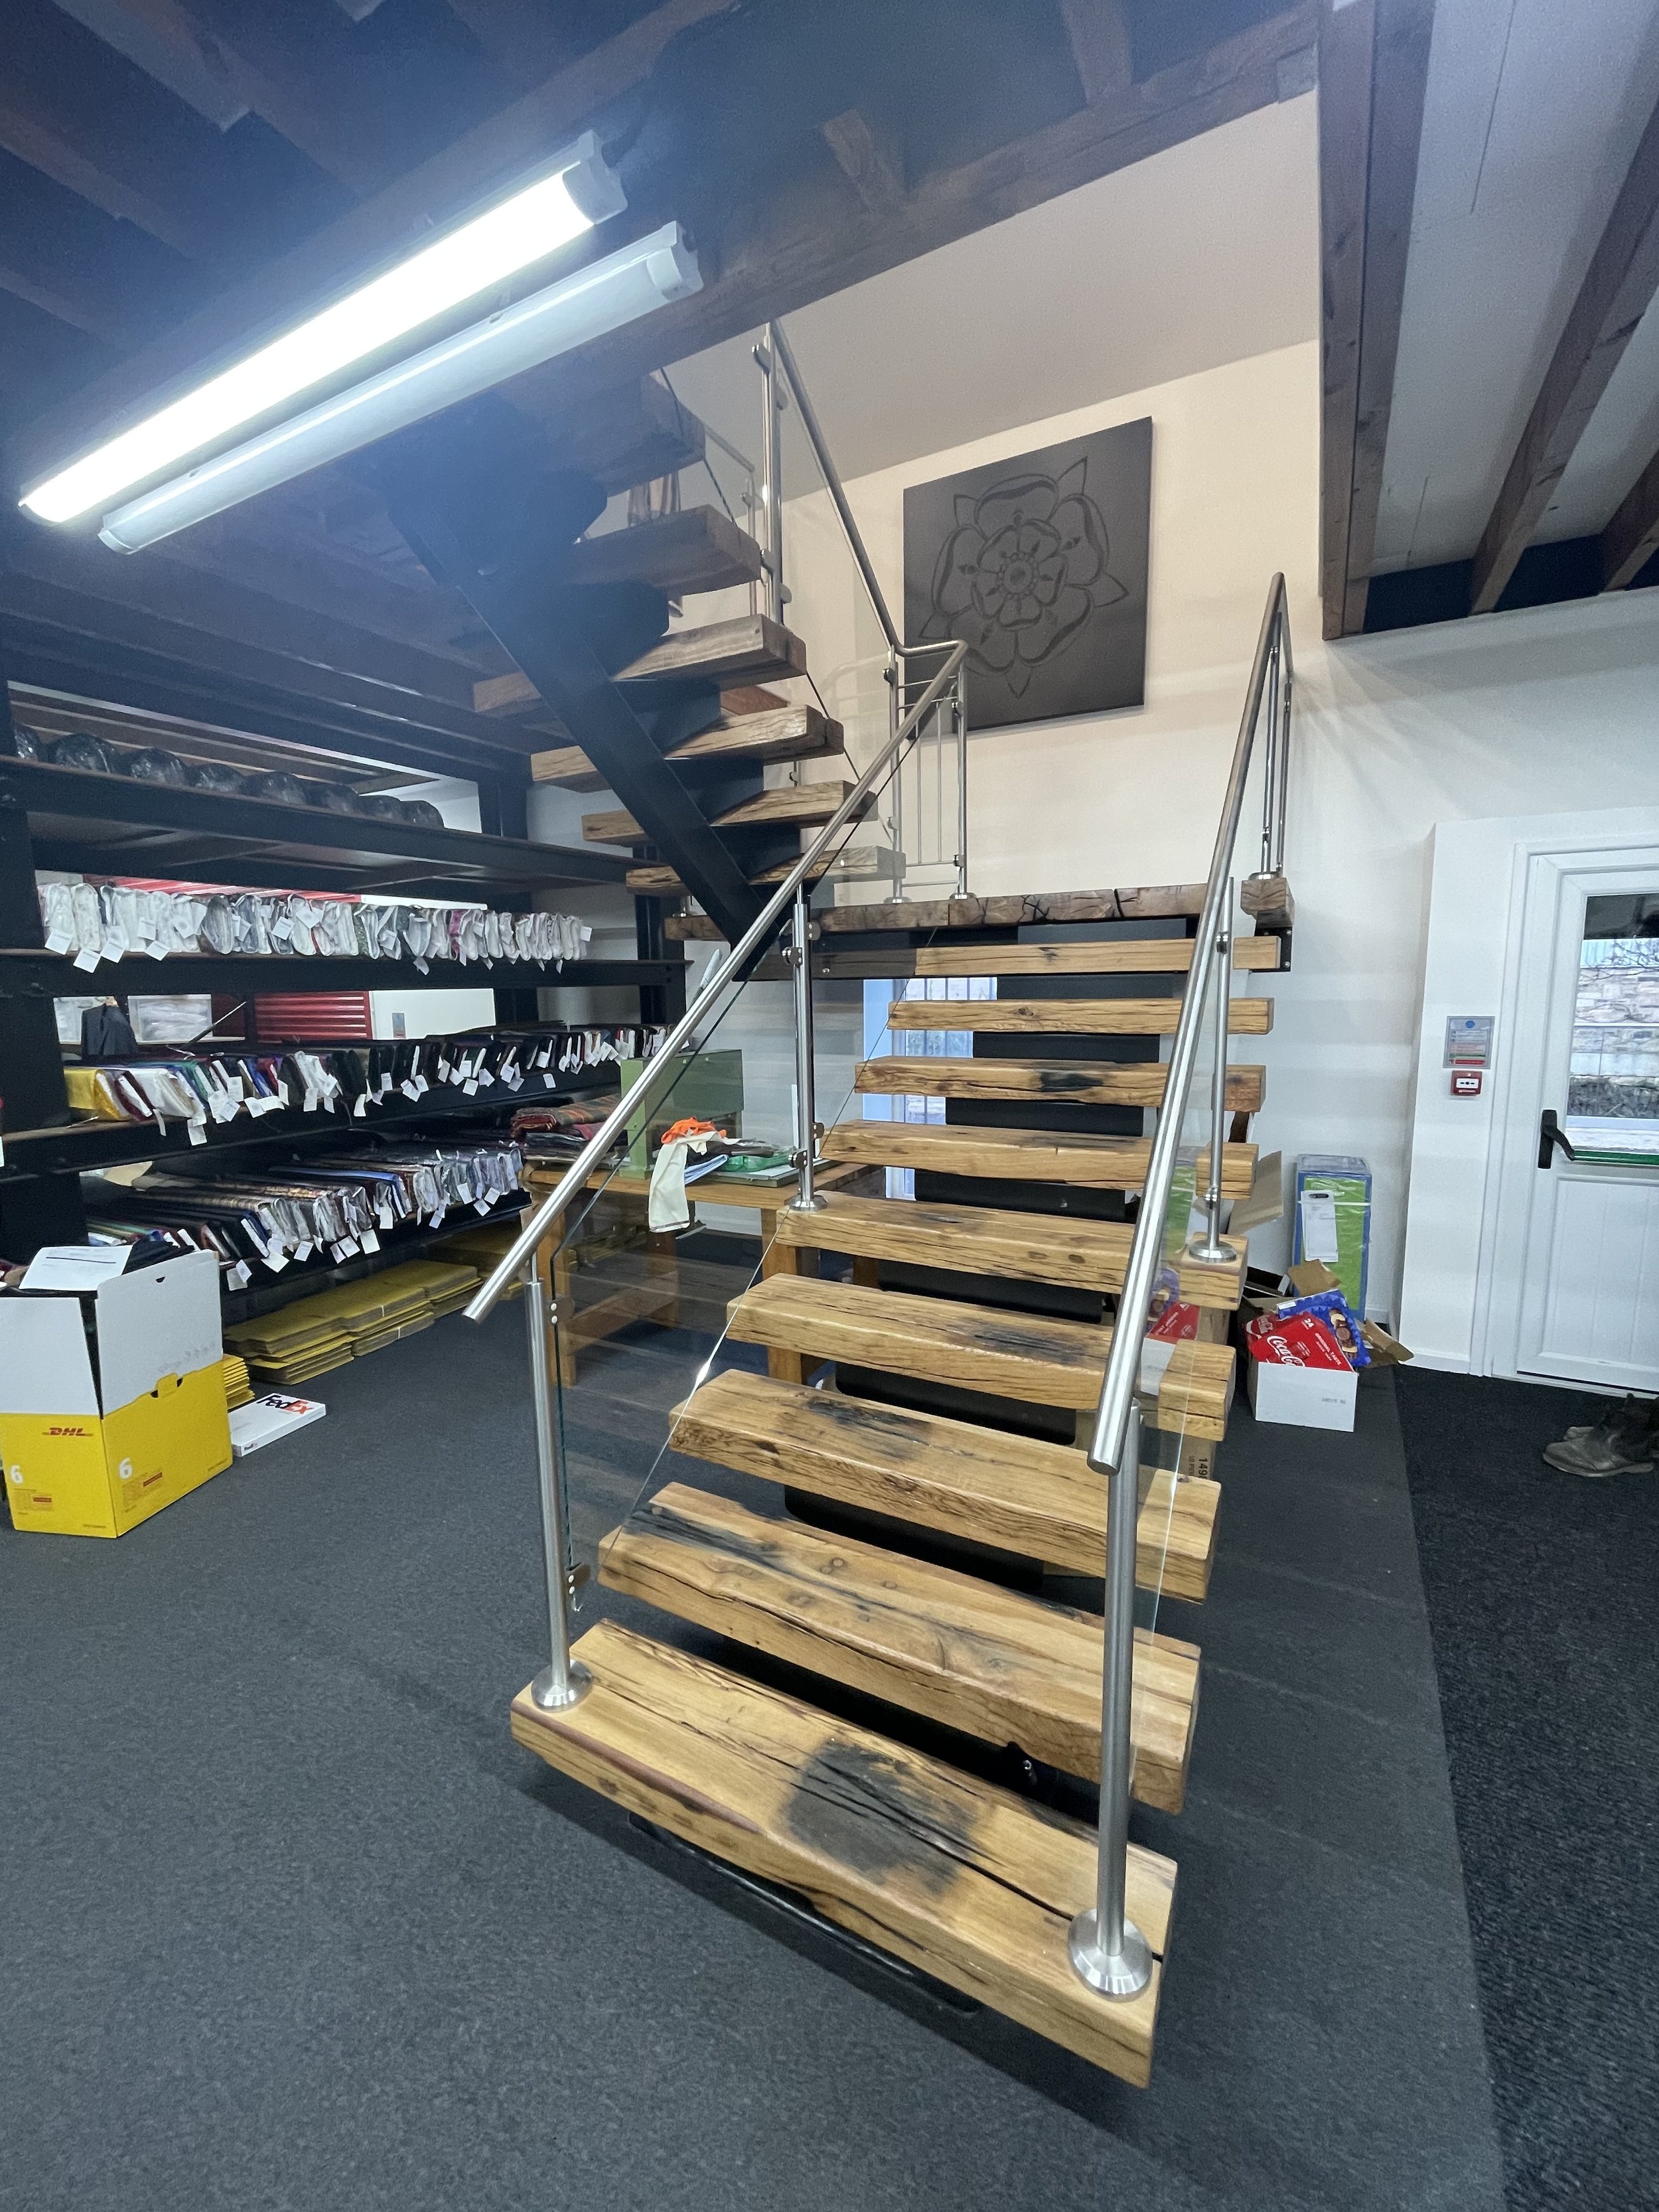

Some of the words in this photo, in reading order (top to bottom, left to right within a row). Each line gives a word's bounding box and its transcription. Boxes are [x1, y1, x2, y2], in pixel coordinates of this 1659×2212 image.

[1304, 1318, 1314, 1327] 24
[256, 1394, 314, 1414] FedEx
[49, 1427, 86, 1437] DHL
[10, 1465, 23, 1485] 6
[119, 1457, 133, 1479] 6
